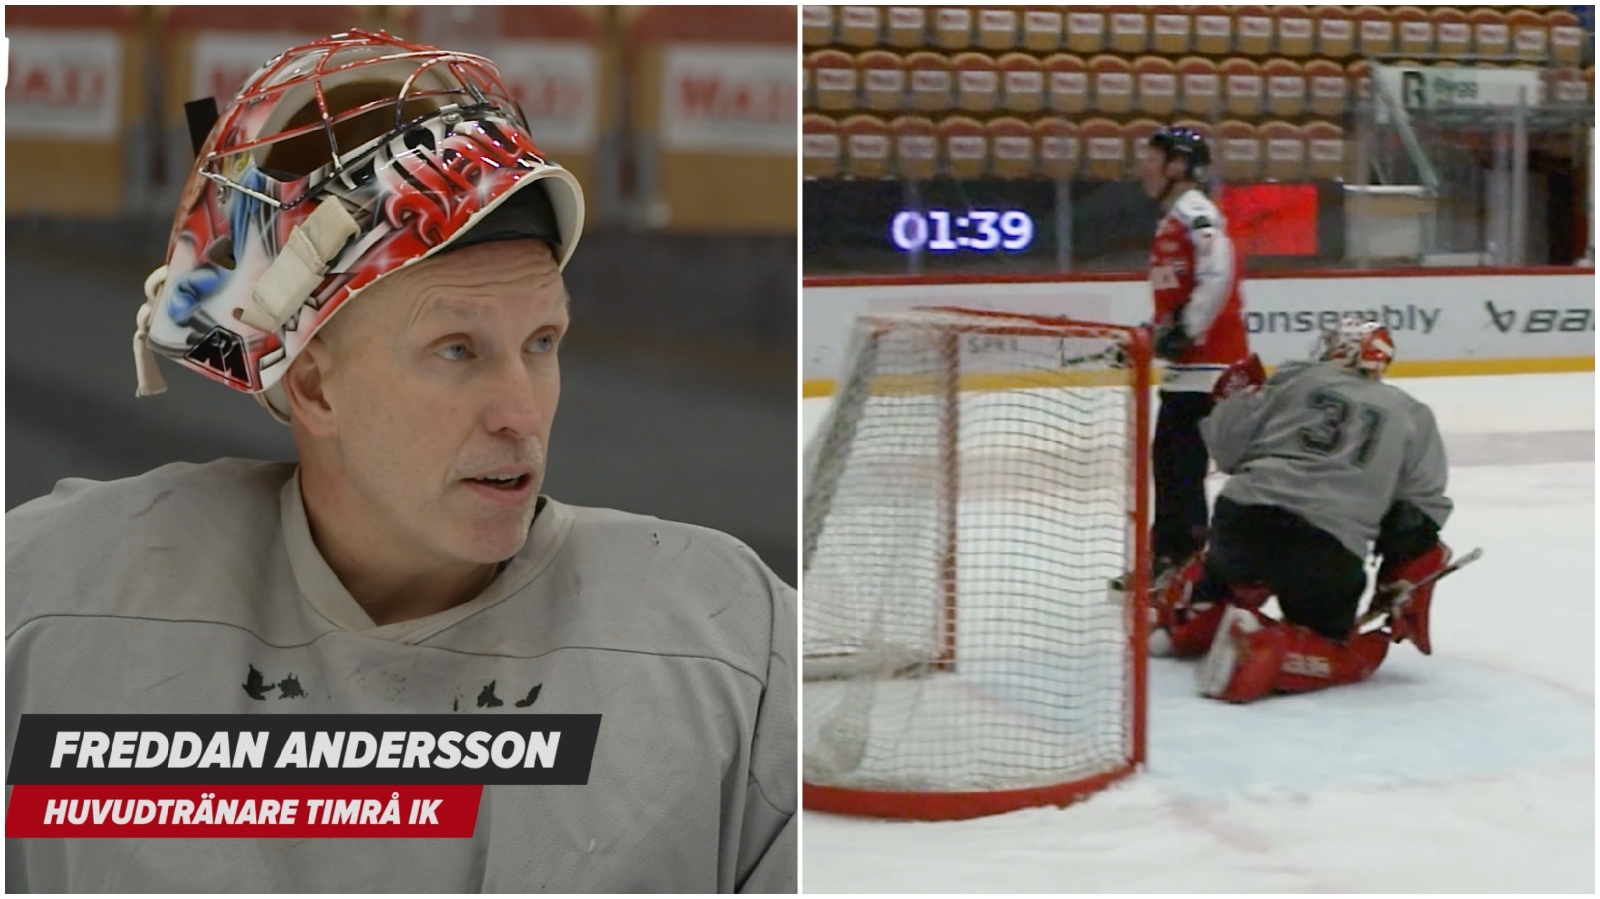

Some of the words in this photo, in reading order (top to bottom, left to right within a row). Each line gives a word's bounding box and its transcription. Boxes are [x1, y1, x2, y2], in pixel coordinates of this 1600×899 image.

[892, 210, 1034, 250] 01:39
[1244, 304, 1441, 334] onsembly
[1301, 388, 1388, 468] 31
